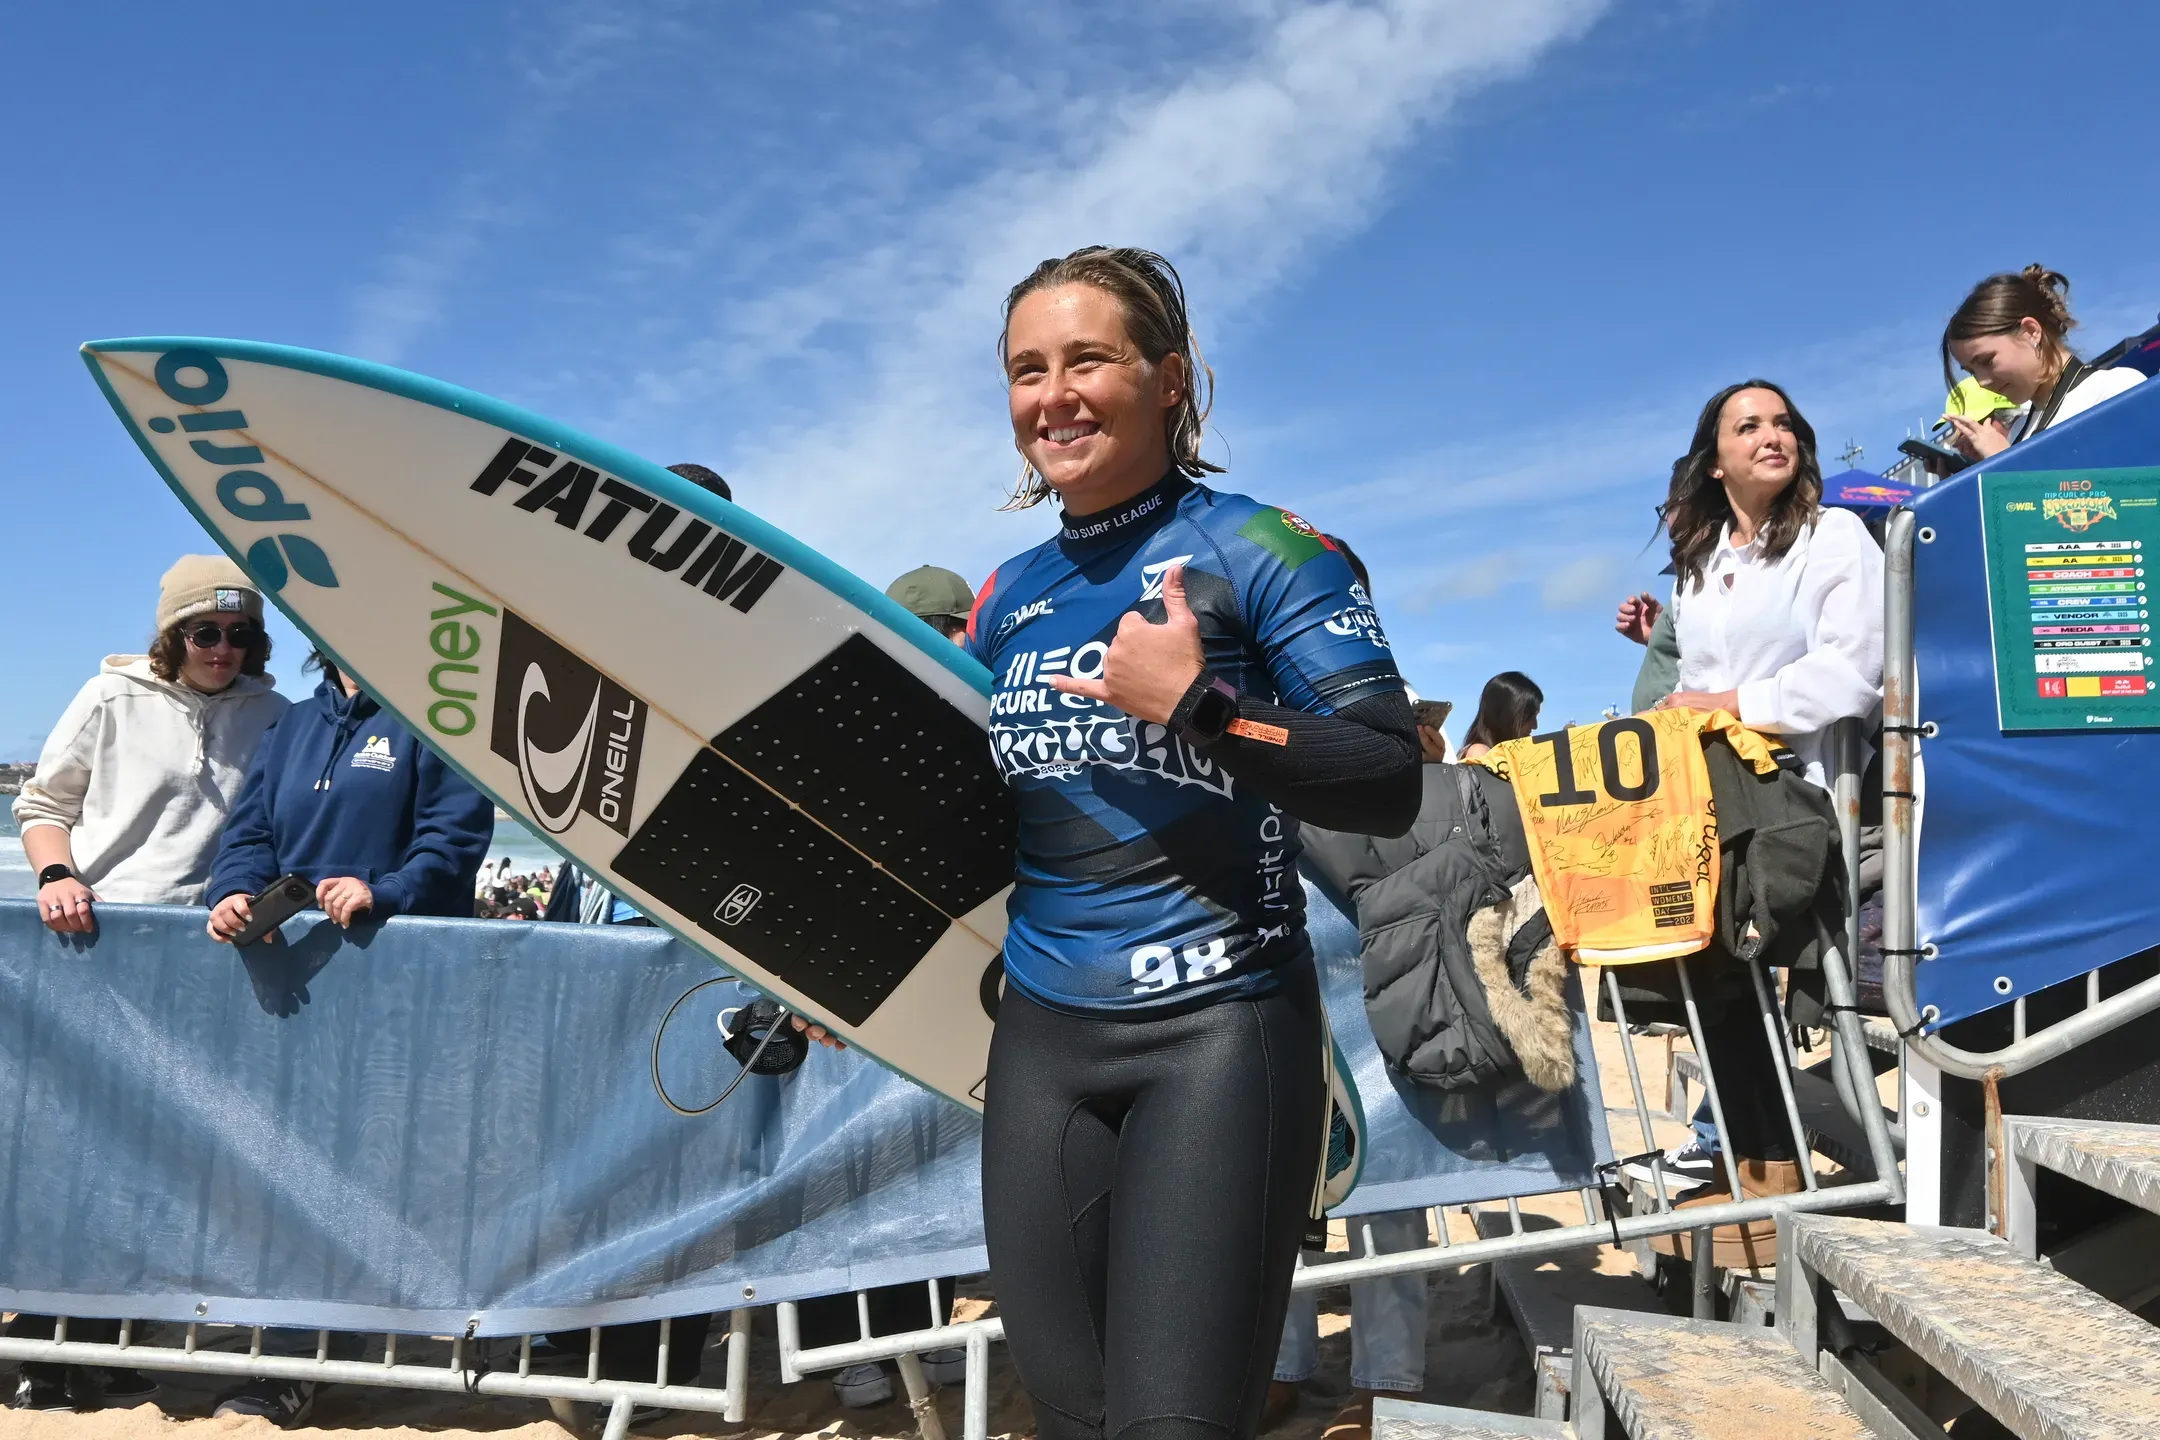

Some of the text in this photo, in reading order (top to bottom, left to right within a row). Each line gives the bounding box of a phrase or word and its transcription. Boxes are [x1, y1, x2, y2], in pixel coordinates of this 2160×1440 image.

[148, 347, 312, 522] prio
[469, 437, 785, 614] FATUM
[1079, 520, 1111, 538] SURF
[1113, 494, 1163, 527] LEAGUE
[2053, 571, 2092, 579] COACH
[2057, 598, 2091, 606] CREW
[427, 581, 498, 737] oney
[1003, 641, 1110, 687] MEO
[599, 699, 635, 824] O'NEILL
[1040, 764, 1072, 774] 2025
[1532, 717, 1661, 808] 10
[1650, 884, 1671, 894] INT'L
[1652, 893, 1692, 905] WOMEN'S
[1655, 907, 1670, 916] DAY
[1130, 934, 1233, 995] 98
